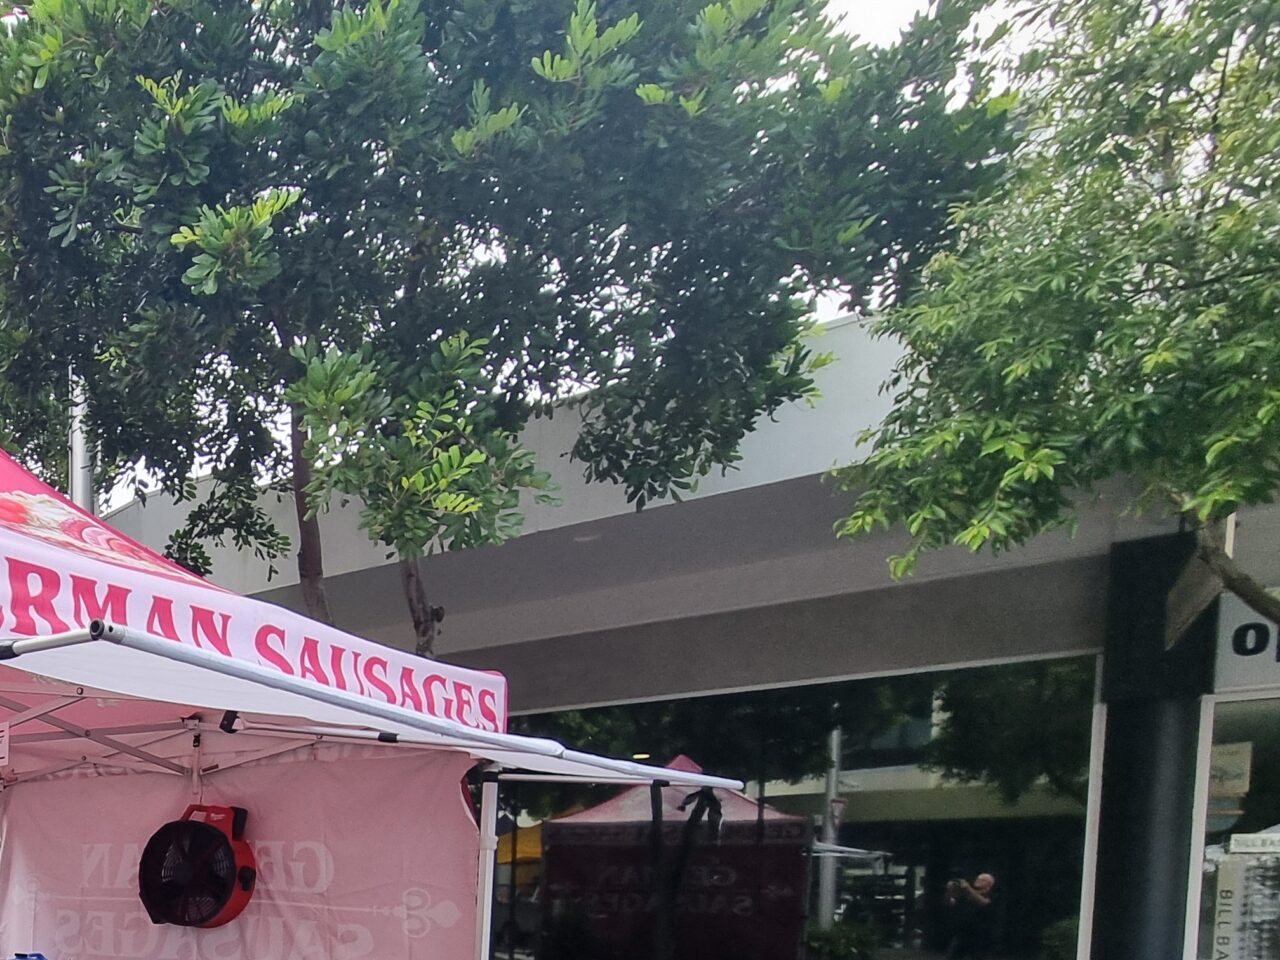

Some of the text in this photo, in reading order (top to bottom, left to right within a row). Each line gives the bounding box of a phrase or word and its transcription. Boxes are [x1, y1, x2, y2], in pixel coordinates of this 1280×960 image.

[1232, 622, 1280, 662] o
[253, 624, 498, 732] SAUSAGES
[1217, 888, 1234, 928] BILL
